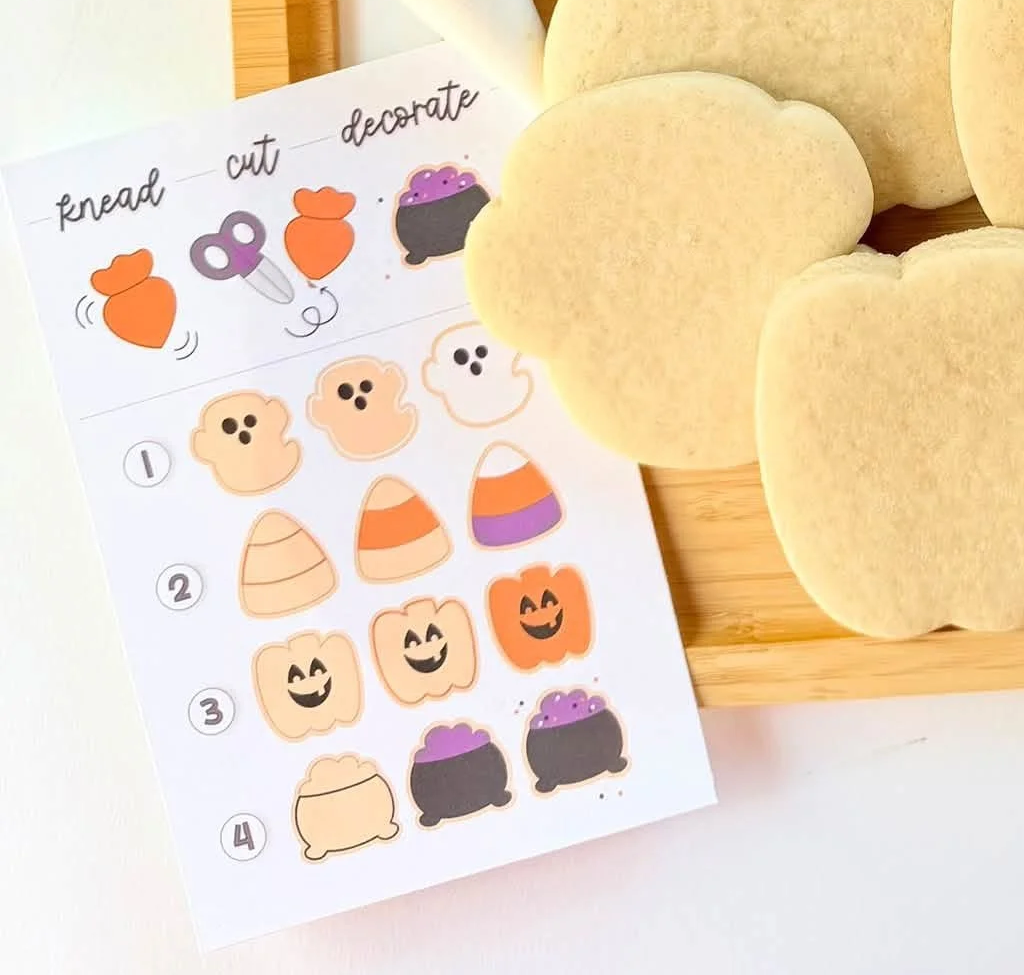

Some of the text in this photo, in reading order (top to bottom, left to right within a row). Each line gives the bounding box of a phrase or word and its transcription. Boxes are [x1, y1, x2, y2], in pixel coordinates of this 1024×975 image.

[56, 79, 480, 232] knead cut decorate
[140, 449, 155, 479] 1
[167, 573, 191, 604] 2
[199, 697, 224, 726] 3
[233, 821, 256, 851] 4
